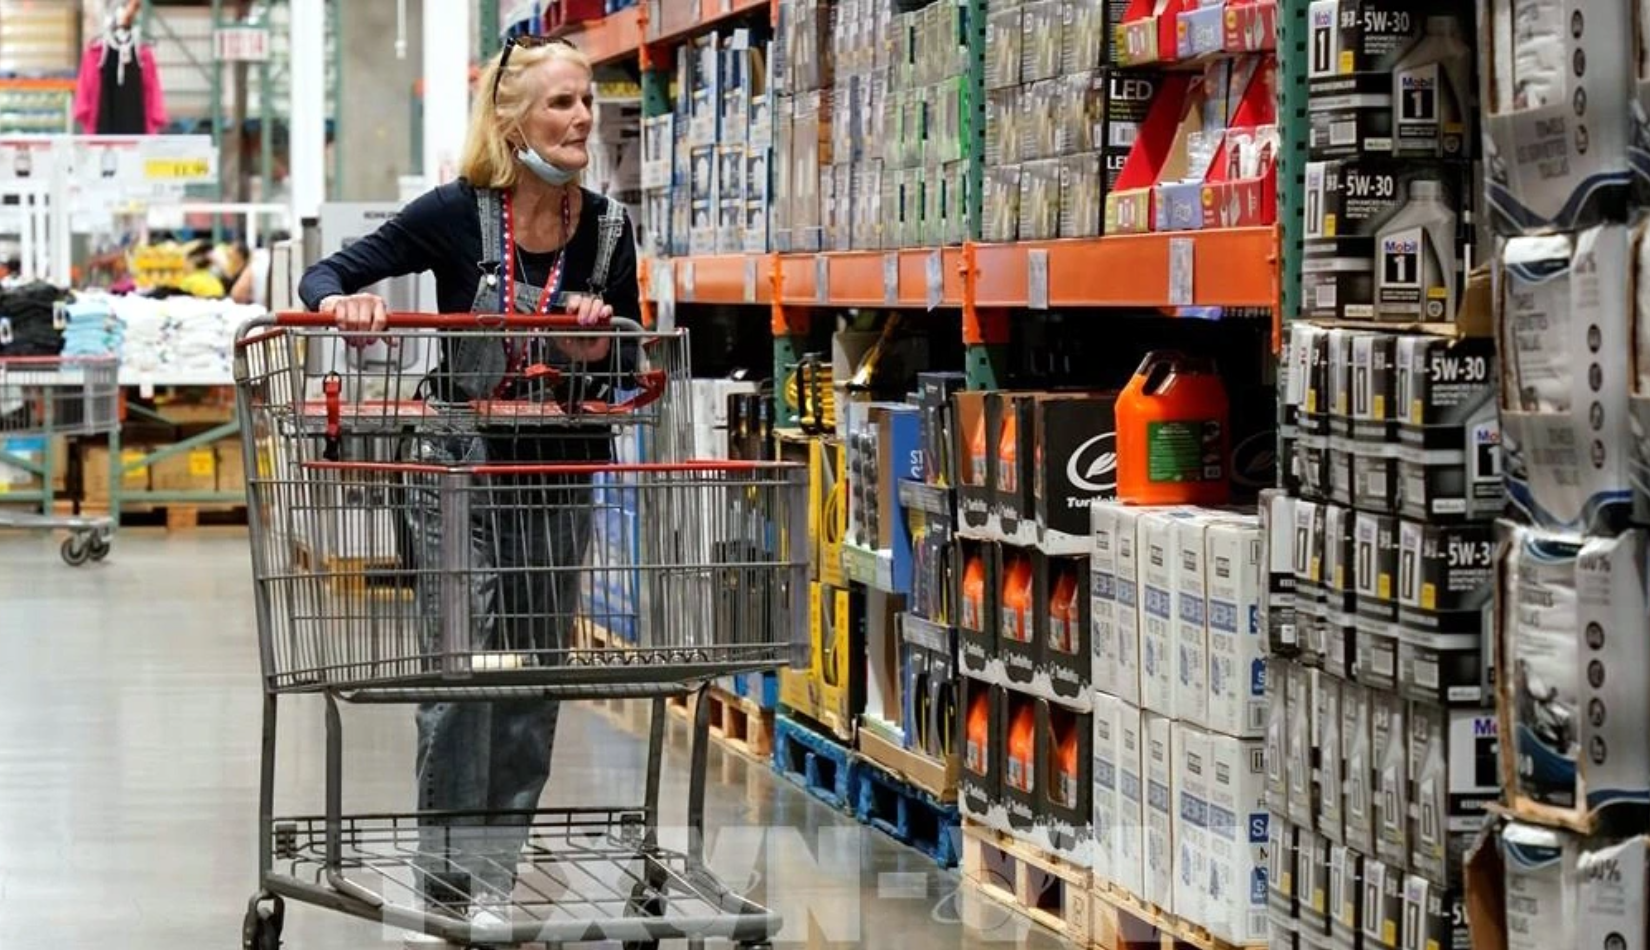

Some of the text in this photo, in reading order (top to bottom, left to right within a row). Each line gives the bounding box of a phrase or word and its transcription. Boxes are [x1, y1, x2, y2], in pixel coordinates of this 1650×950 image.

[1314, 11, 1333, 26] Mobil
[1364, 12, 1410, 32] 5W-30
[1109, 79, 1154, 100] LED
[1403, 77, 1434, 90] Mobil
[1107, 156, 1125, 170] LE
[1346, 175, 1394, 197] 5W-30
[1384, 240, 1418, 253] Mobil
[1394, 255, 1406, 282] 1
[1431, 356, 1486, 382] 5W-30
